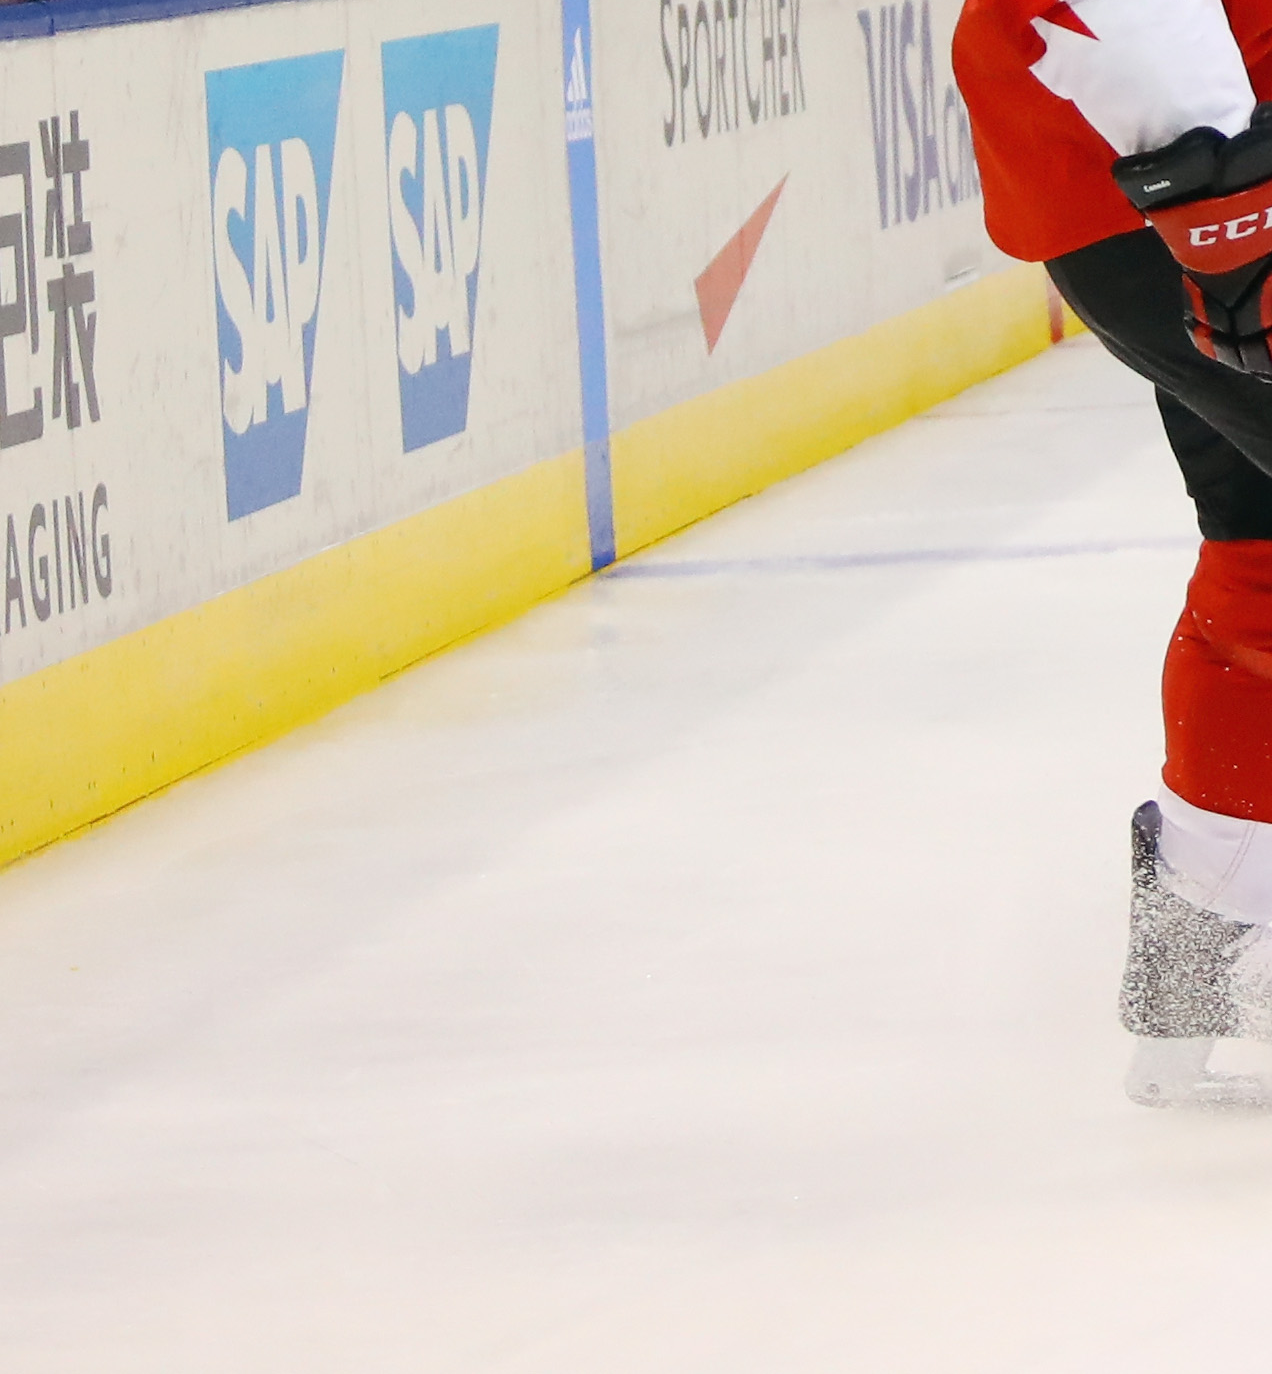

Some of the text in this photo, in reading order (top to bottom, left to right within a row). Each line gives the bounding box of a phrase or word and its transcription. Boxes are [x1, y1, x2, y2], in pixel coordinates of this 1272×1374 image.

[213, 137, 320, 435] SAP
[388, 103, 481, 375] SAP
[3, 481, 112, 629] AGING
